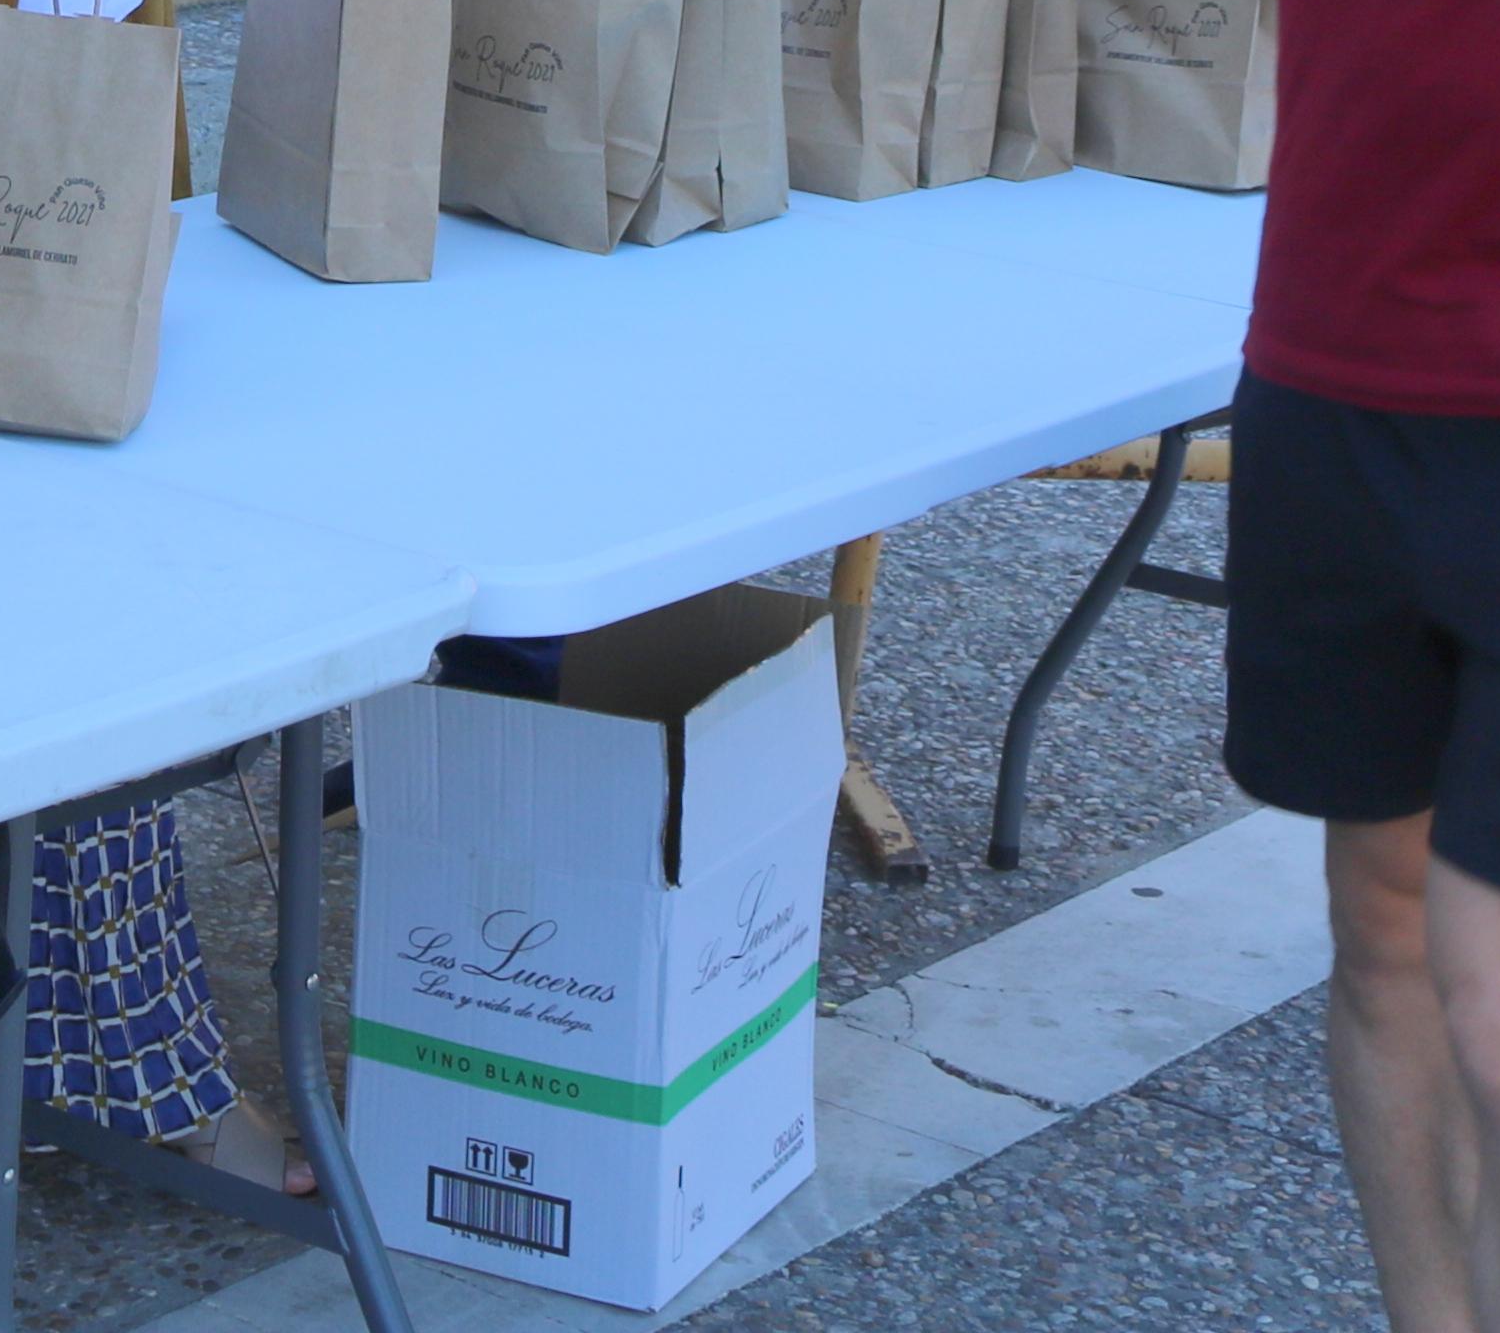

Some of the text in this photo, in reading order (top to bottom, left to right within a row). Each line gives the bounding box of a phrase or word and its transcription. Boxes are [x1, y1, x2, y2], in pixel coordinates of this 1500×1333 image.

[475, 35, 522, 94] Roque
[56, 200, 95, 227] 2021
[32, 248, 43, 261] DE
[724, 863, 796, 970] Luceras
[397, 909, 616, 1003] Las Luceras
[454, 994, 473, 1010] y
[475, 997, 512, 1014] vida
[514, 1002, 533, 1019] de
[711, 1007, 782, 1072] VINO BLANCO
[415, 1044, 581, 1099] VINO BLANCO
